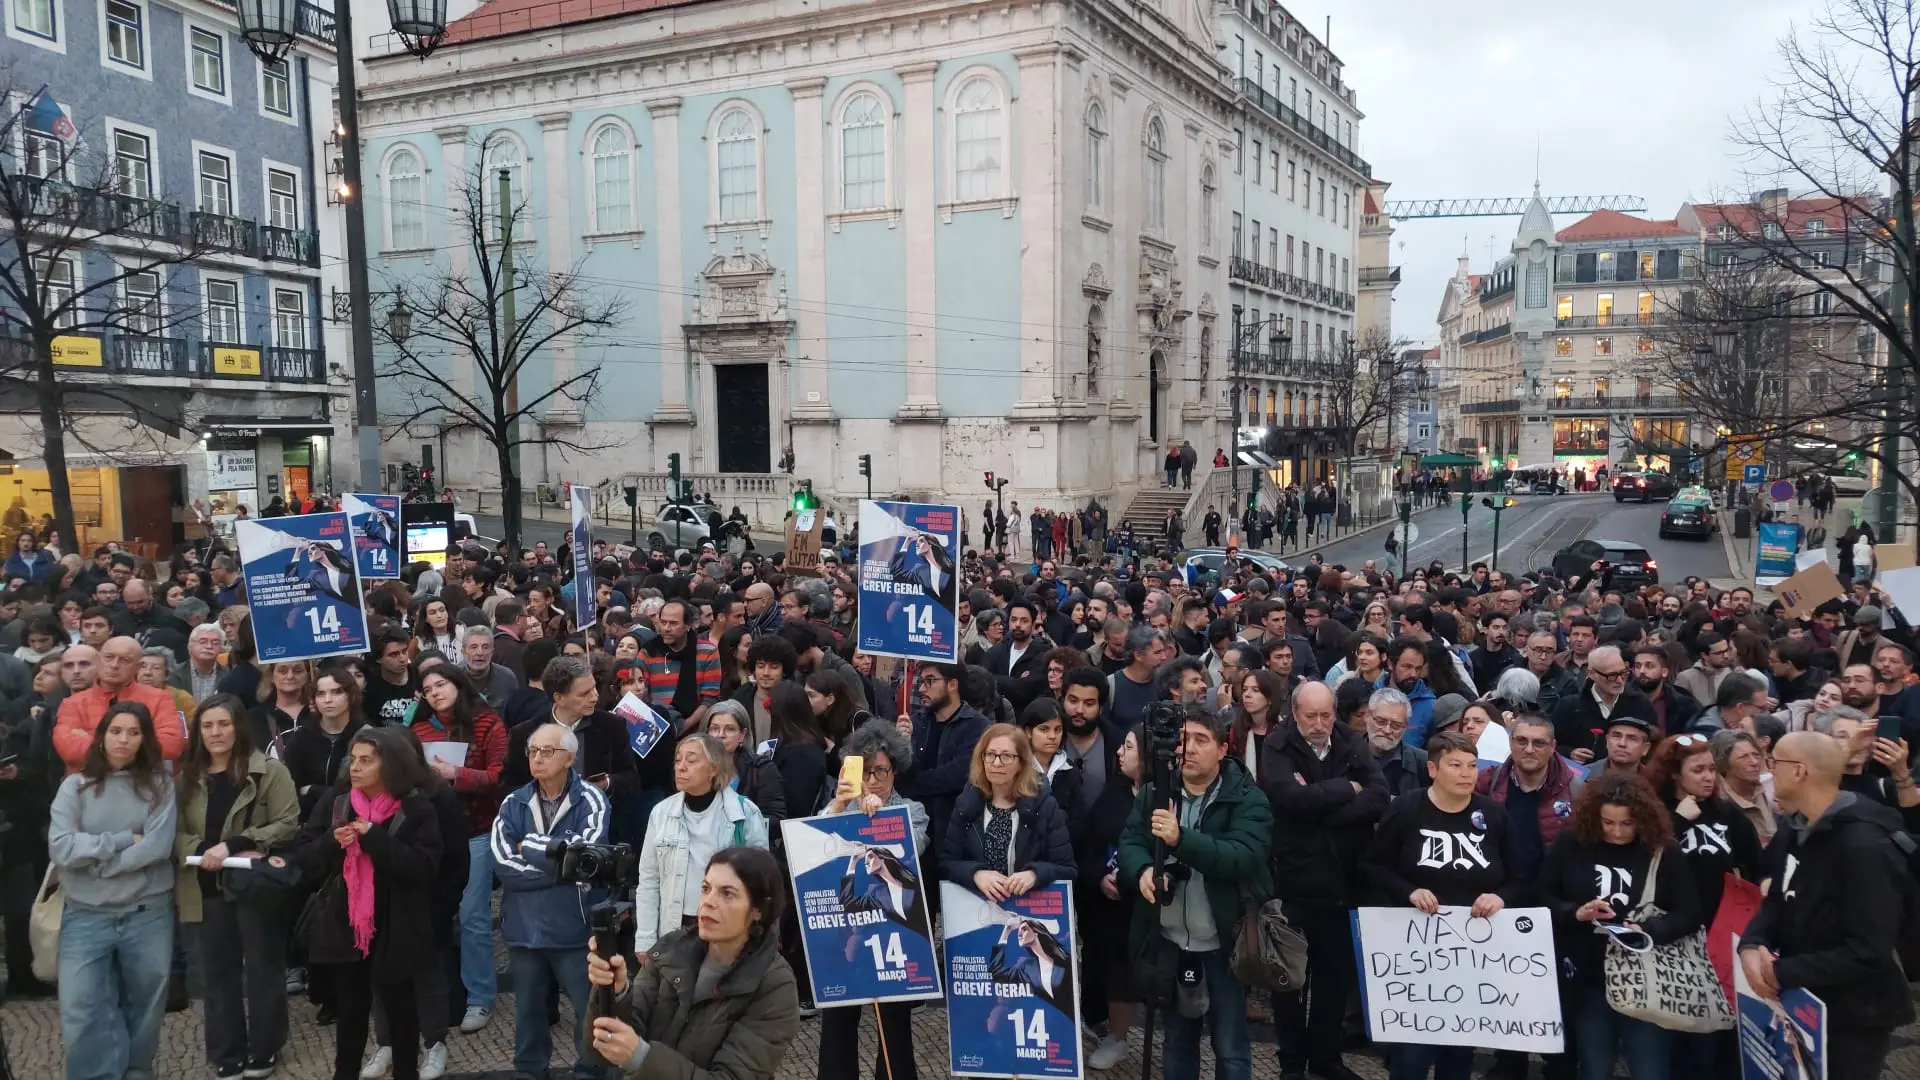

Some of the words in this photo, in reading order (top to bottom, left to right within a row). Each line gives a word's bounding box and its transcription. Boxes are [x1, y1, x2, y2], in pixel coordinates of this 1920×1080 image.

[1749, 468, 1760, 478] P
[370, 548, 388, 565] 14
[862, 580, 892, 593] GREVE
[894, 582, 925, 596] GERAL
[304, 605, 341, 635] 14
[903, 604, 935, 635] 14
[314, 632, 340, 643] MARÇO
[908, 634, 932, 646] MARÇO
[636, 732, 648, 746] 14
[1416, 828, 1491, 870] DN
[804, 889, 835, 899] JORNALISTAS
[805, 898, 816, 906] SEM
[817, 896, 839, 905] DIREITOS
[806, 905, 816, 914] NÃO
[817, 904, 827, 913] SÃO
[828, 904, 845, 912] LIVRES
[808, 914, 846, 930] GREVE
[848, 908, 888, 927] GERAL
[1516, 919, 1533, 930] DN
[1406, 910, 1493, 944] NÃO
[864, 932, 908, 971] 14
[952, 956, 985, 964] JORNALISTAS
[1372, 947, 1548, 978] DESISTIMOS
[877, 969, 907, 982] MARÇO
[952, 964, 964, 972] SEM
[964, 964, 987, 972] DIREITOS
[953, 970, 963, 980] NÃO
[964, 971, 974, 980] SÃO
[953, 981, 992, 996] GREVE
[994, 982, 1034, 998] GERAL
[1386, 981, 1464, 1004] PELO
[1478, 982, 1520, 1007] DN
[1380, 1008, 1446, 1032] PELO
[1008, 1008, 1049, 1048] 14
[1016, 1048, 1047, 1061] MARÇO
